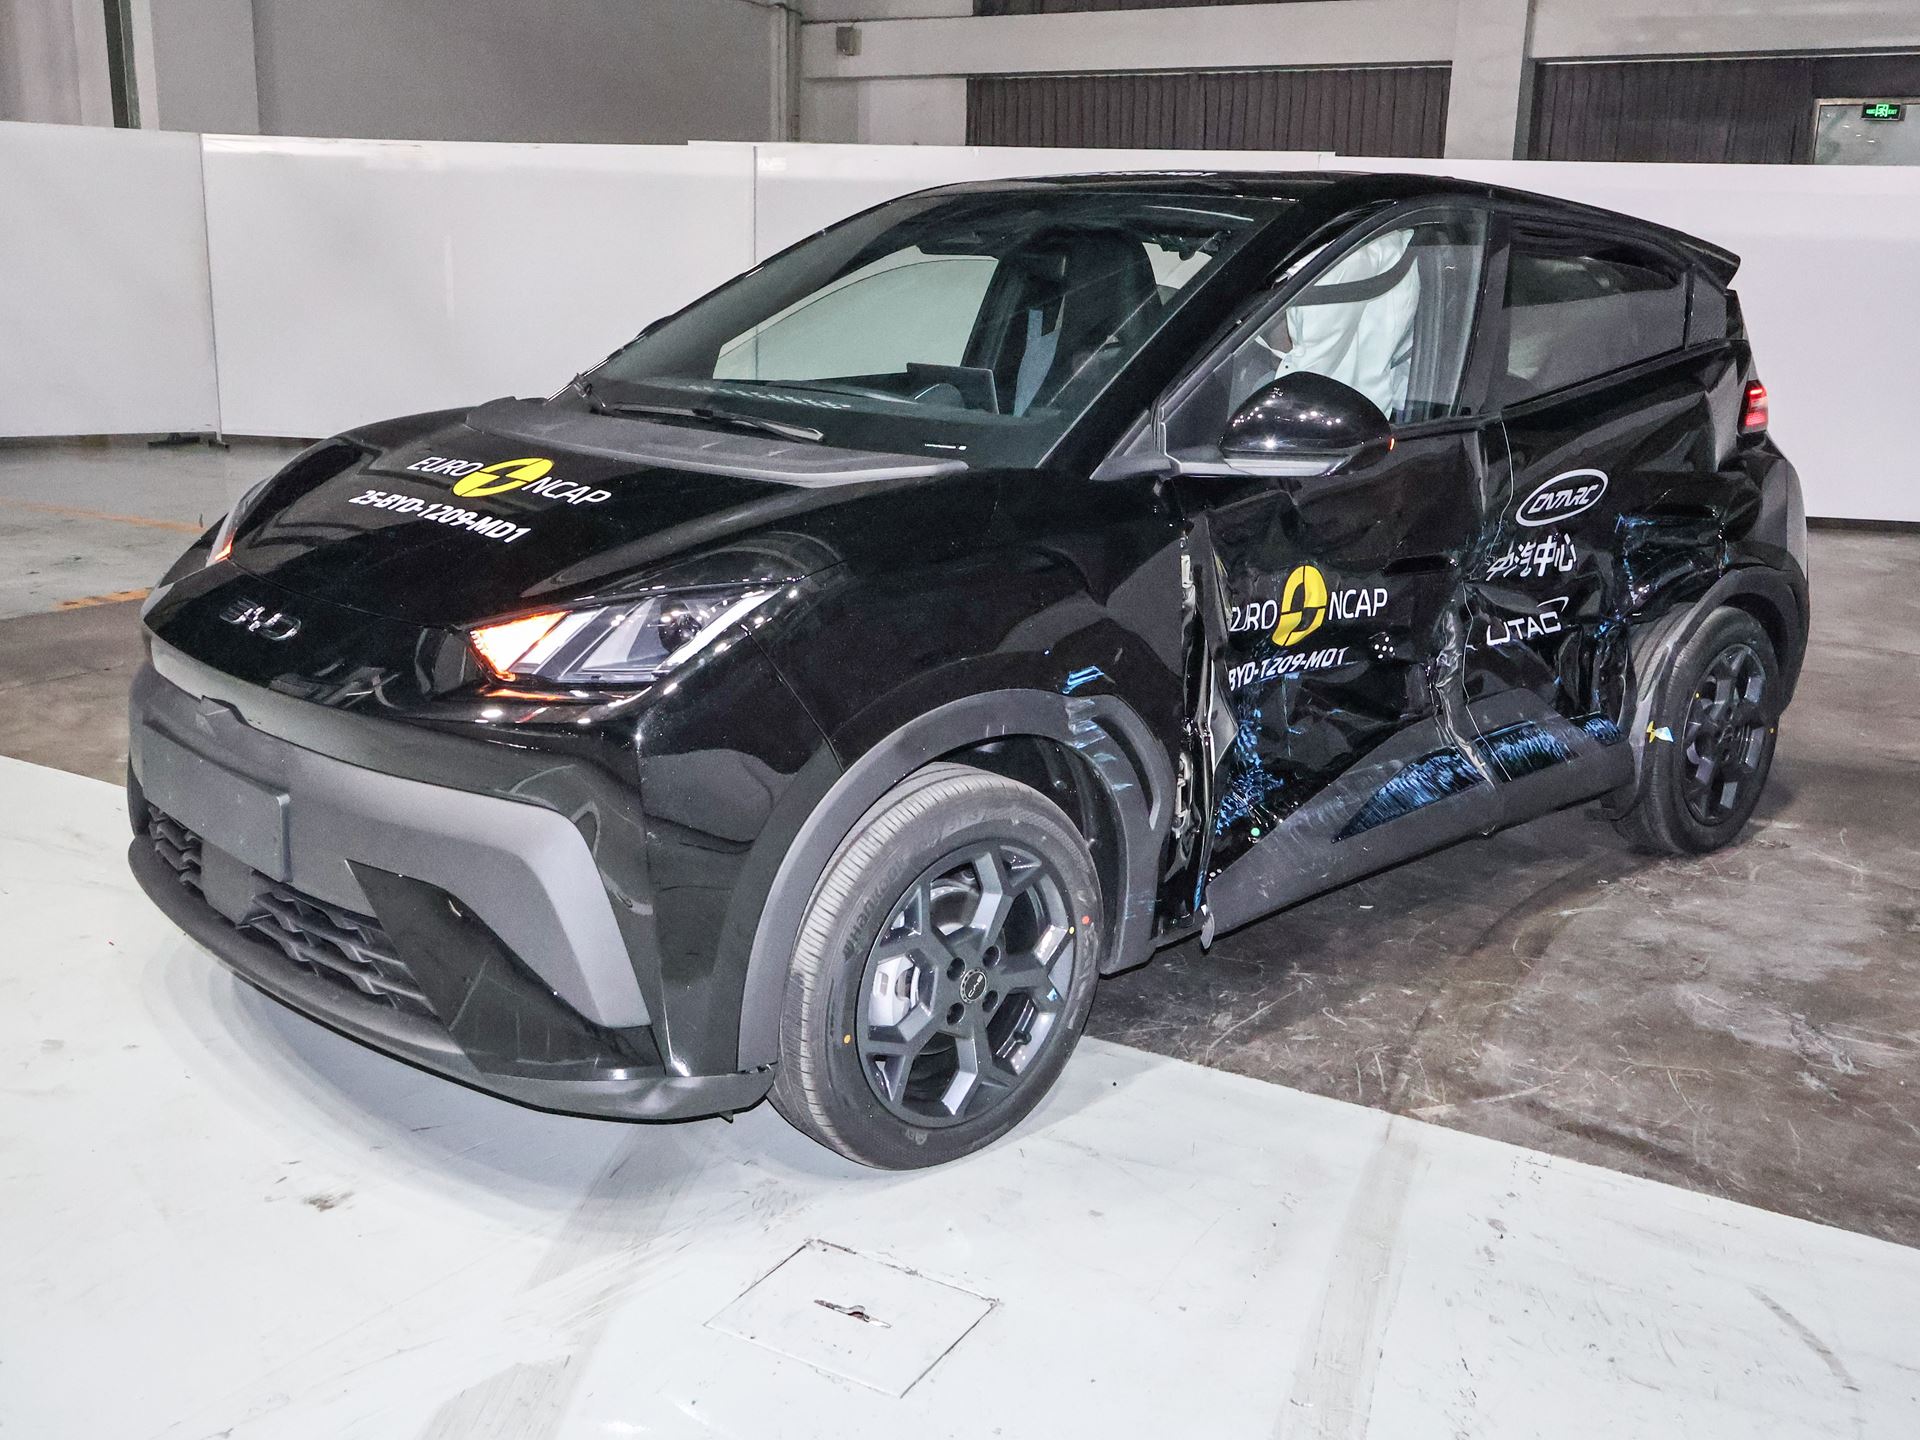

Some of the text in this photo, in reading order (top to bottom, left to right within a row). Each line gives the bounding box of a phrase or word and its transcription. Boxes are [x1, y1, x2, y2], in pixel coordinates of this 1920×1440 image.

[407, 457, 612, 505] EURO NCAP
[348, 489, 532, 543] 25-BYD-1209-MD1
[1486, 532, 1578, 581] 中汽中心
[1230, 588, 1388, 632] URO NCAP
[1486, 611, 1562, 646] UTAC
